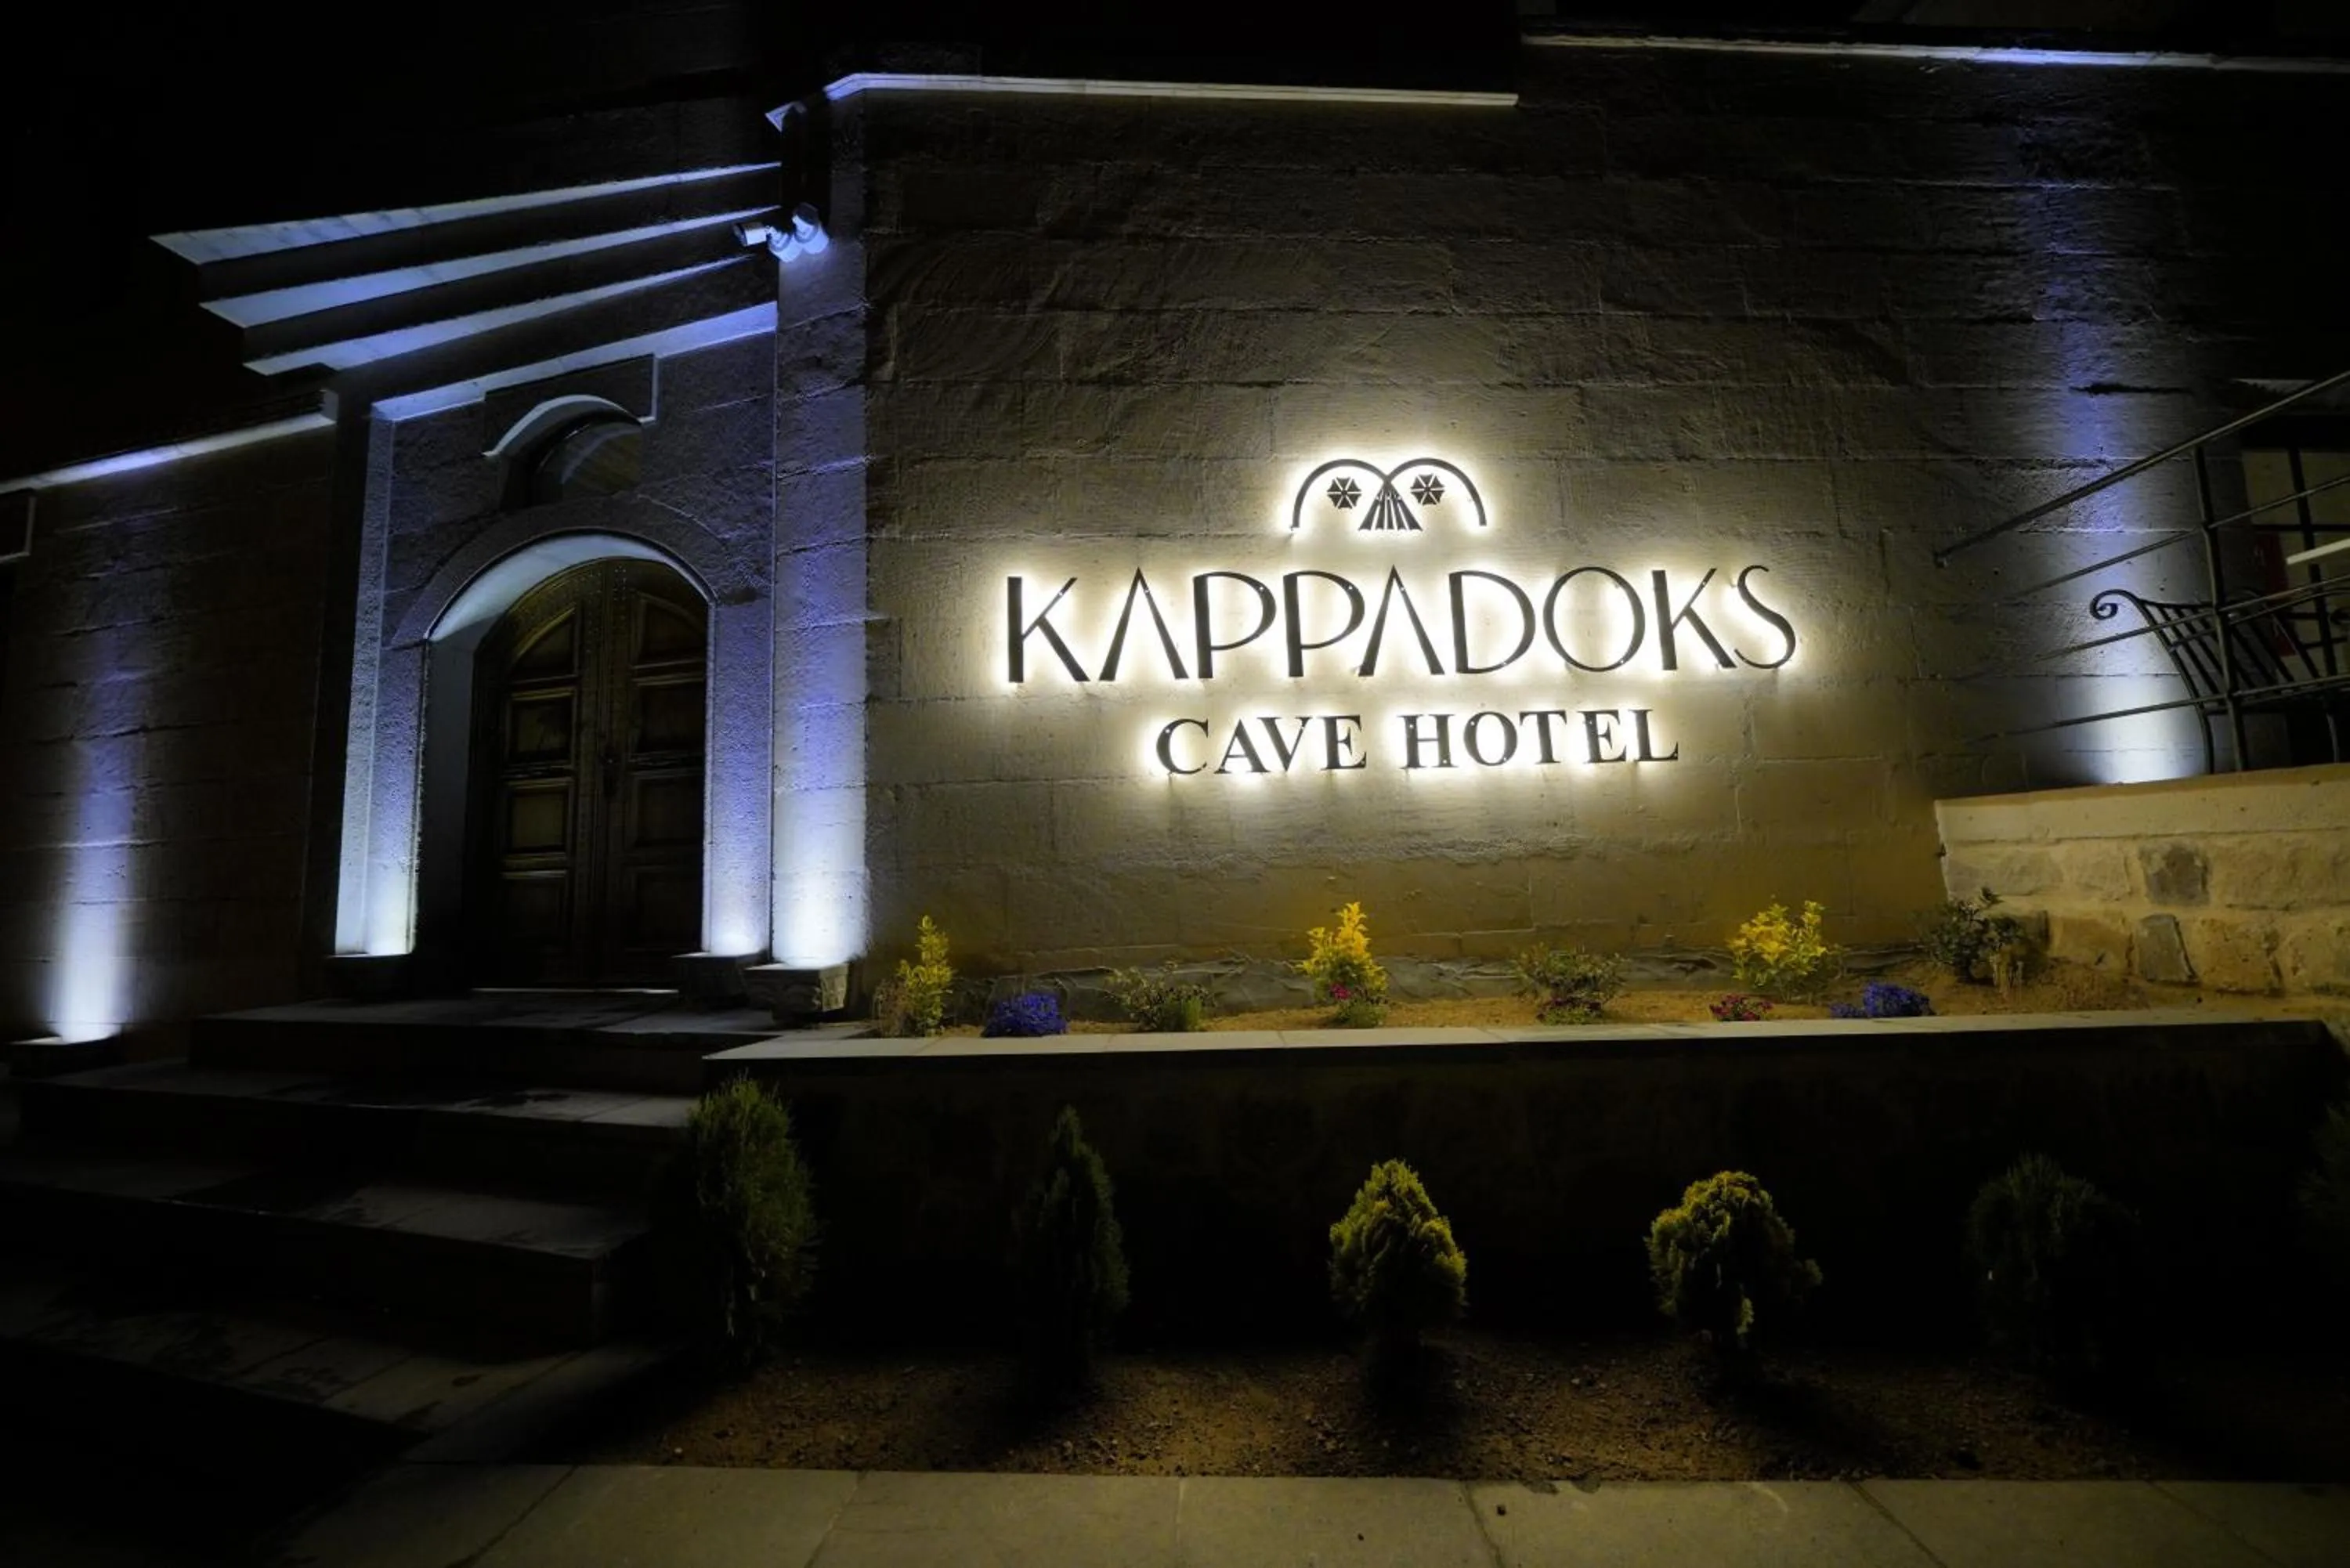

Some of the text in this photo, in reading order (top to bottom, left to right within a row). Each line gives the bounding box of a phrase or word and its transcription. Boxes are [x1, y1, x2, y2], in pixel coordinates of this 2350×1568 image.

[1007, 564, 1797, 684] KAPPADOKS
[1155, 708, 1679, 775] CAVE HOTEL
